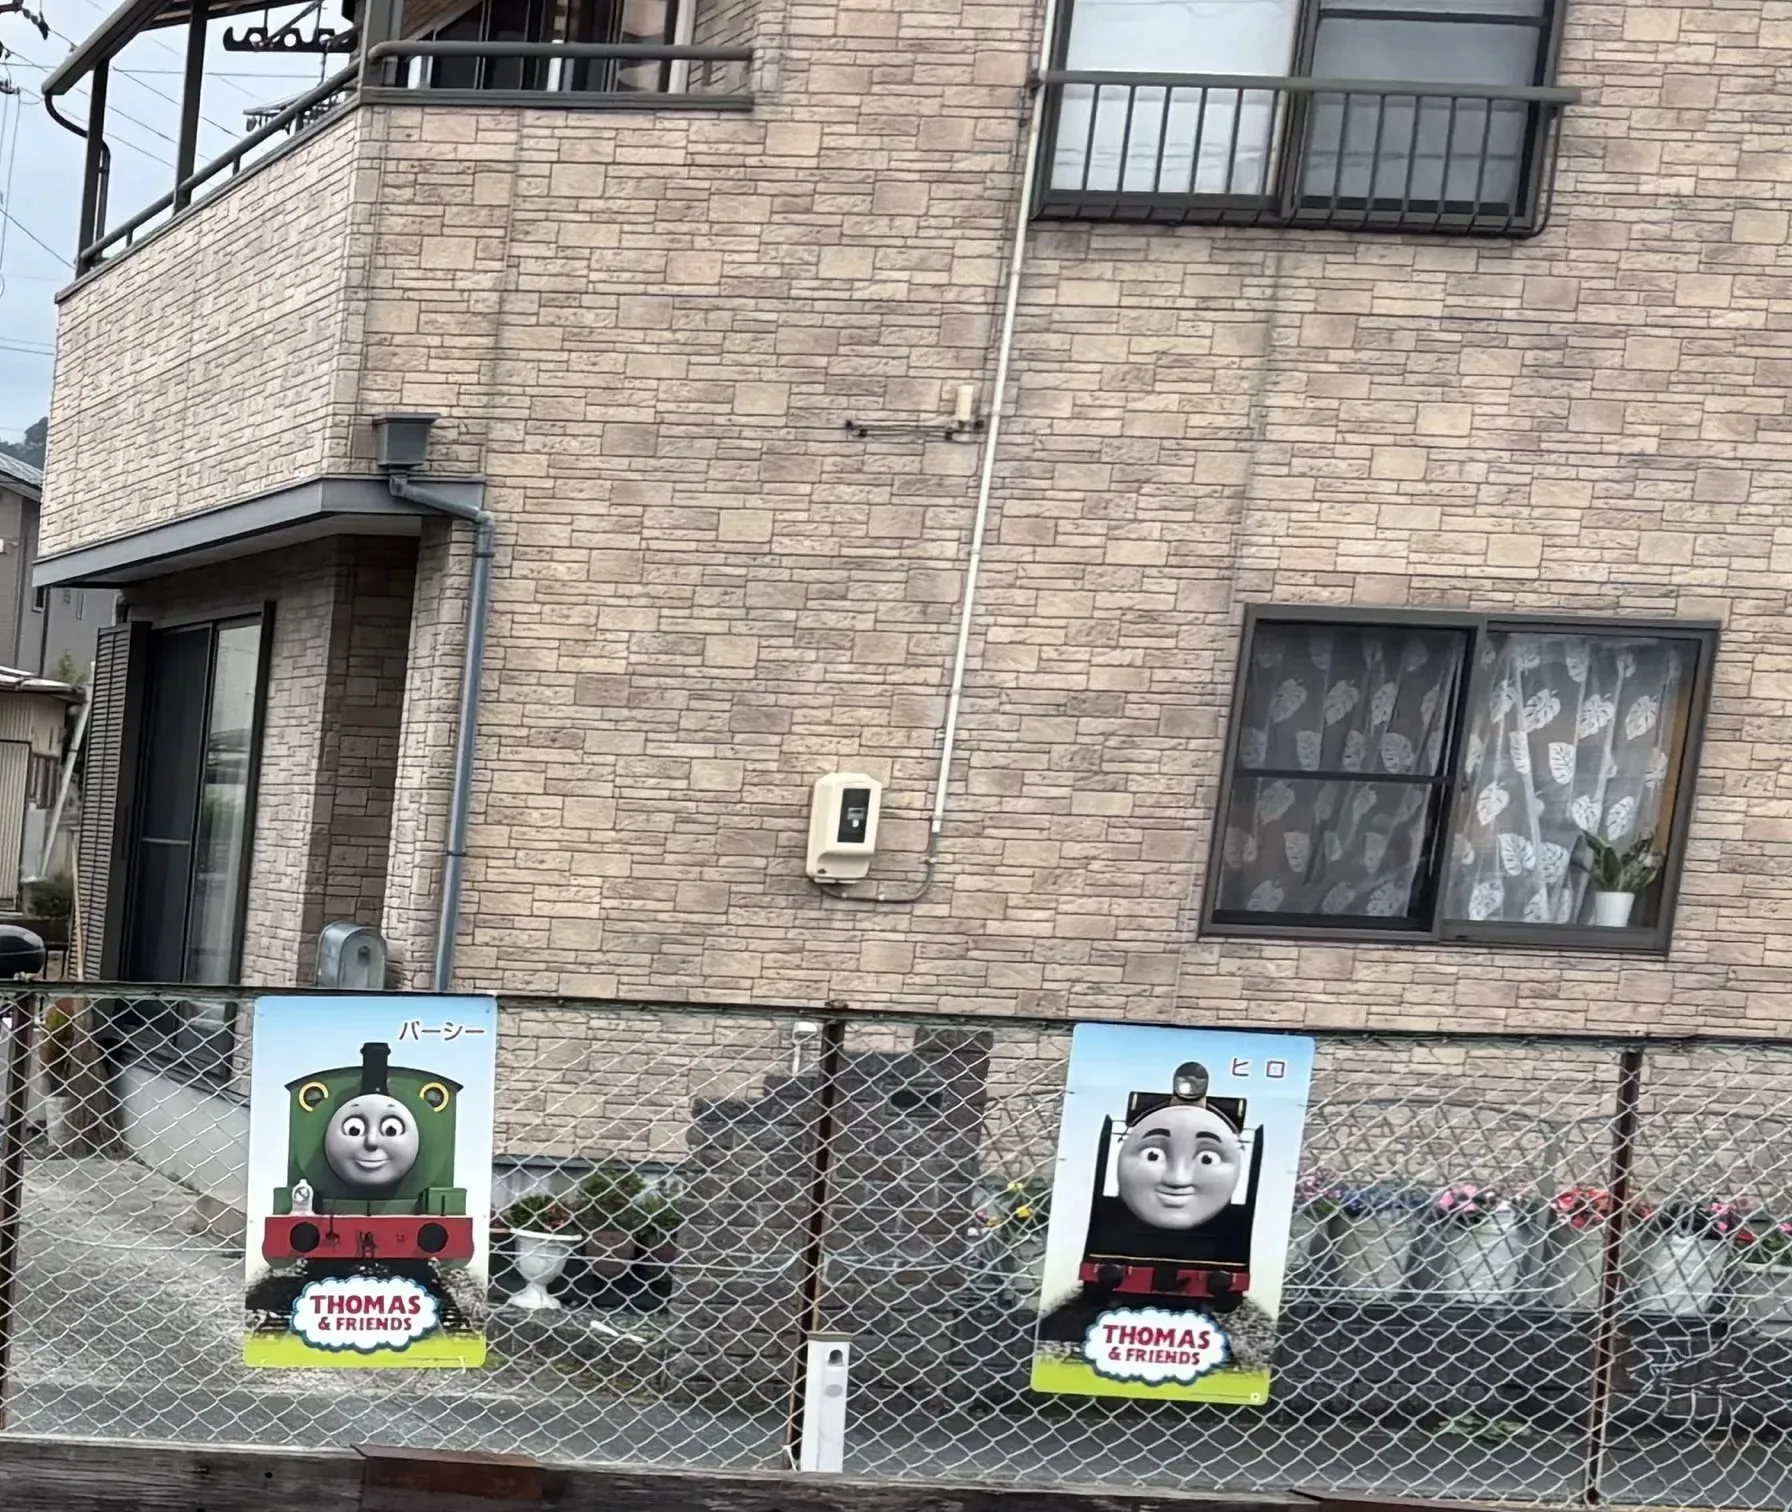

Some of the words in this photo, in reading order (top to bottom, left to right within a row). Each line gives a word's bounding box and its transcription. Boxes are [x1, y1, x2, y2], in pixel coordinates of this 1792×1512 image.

[310, 1295, 421, 1315] THOMAS
[318, 1316, 331, 1331] &
[336, 1317, 412, 1331] FRIENDS
[1103, 1324, 1211, 1350] THOMAS
[1108, 1346, 1121, 1361] &
[1125, 1348, 1200, 1366] FRIENDS
